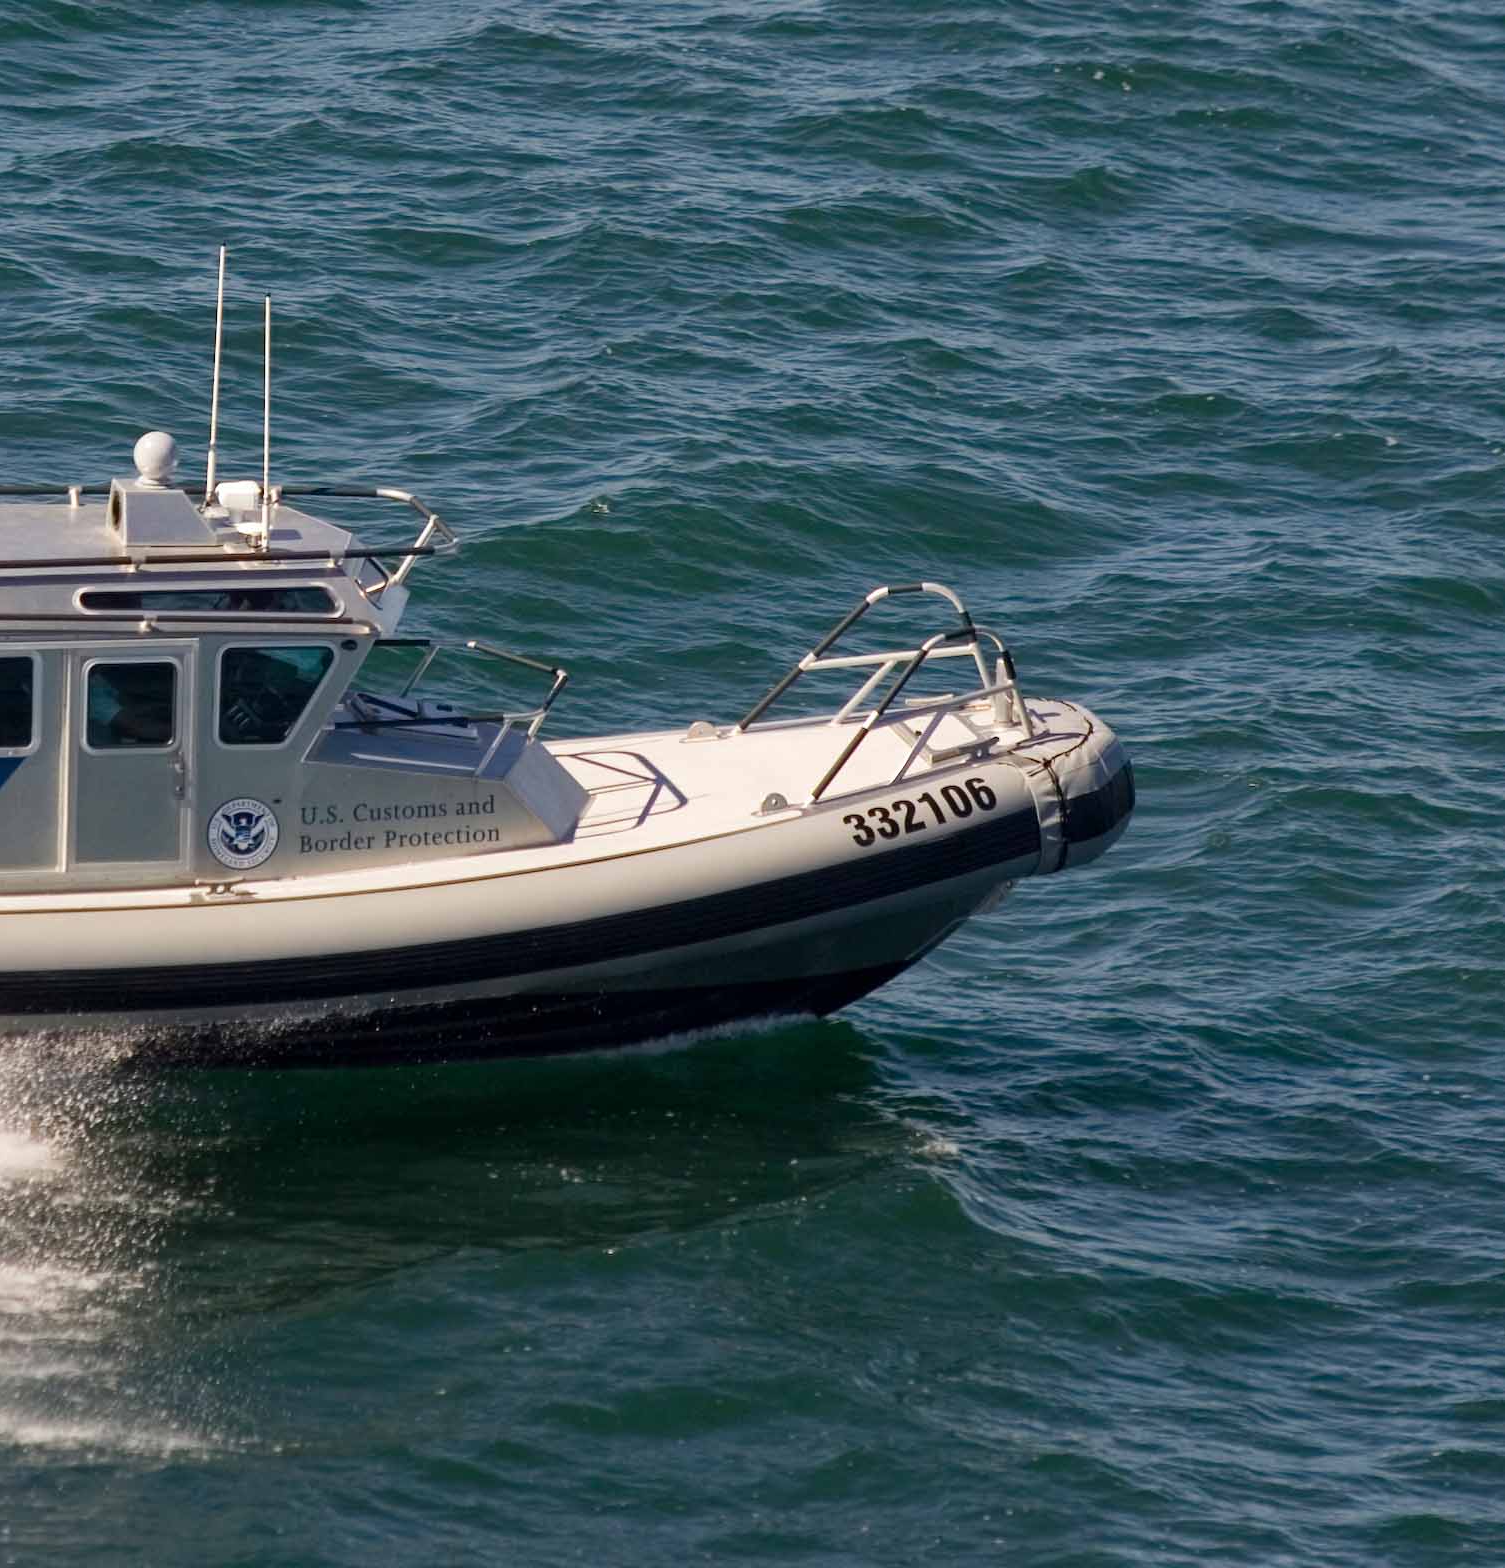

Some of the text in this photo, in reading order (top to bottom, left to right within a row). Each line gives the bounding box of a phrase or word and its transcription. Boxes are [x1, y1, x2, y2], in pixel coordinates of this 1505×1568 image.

[301, 795, 495, 826] U.S. Customs and
[843, 777, 997, 847] 332106
[299, 826, 501, 853] Border Protection
